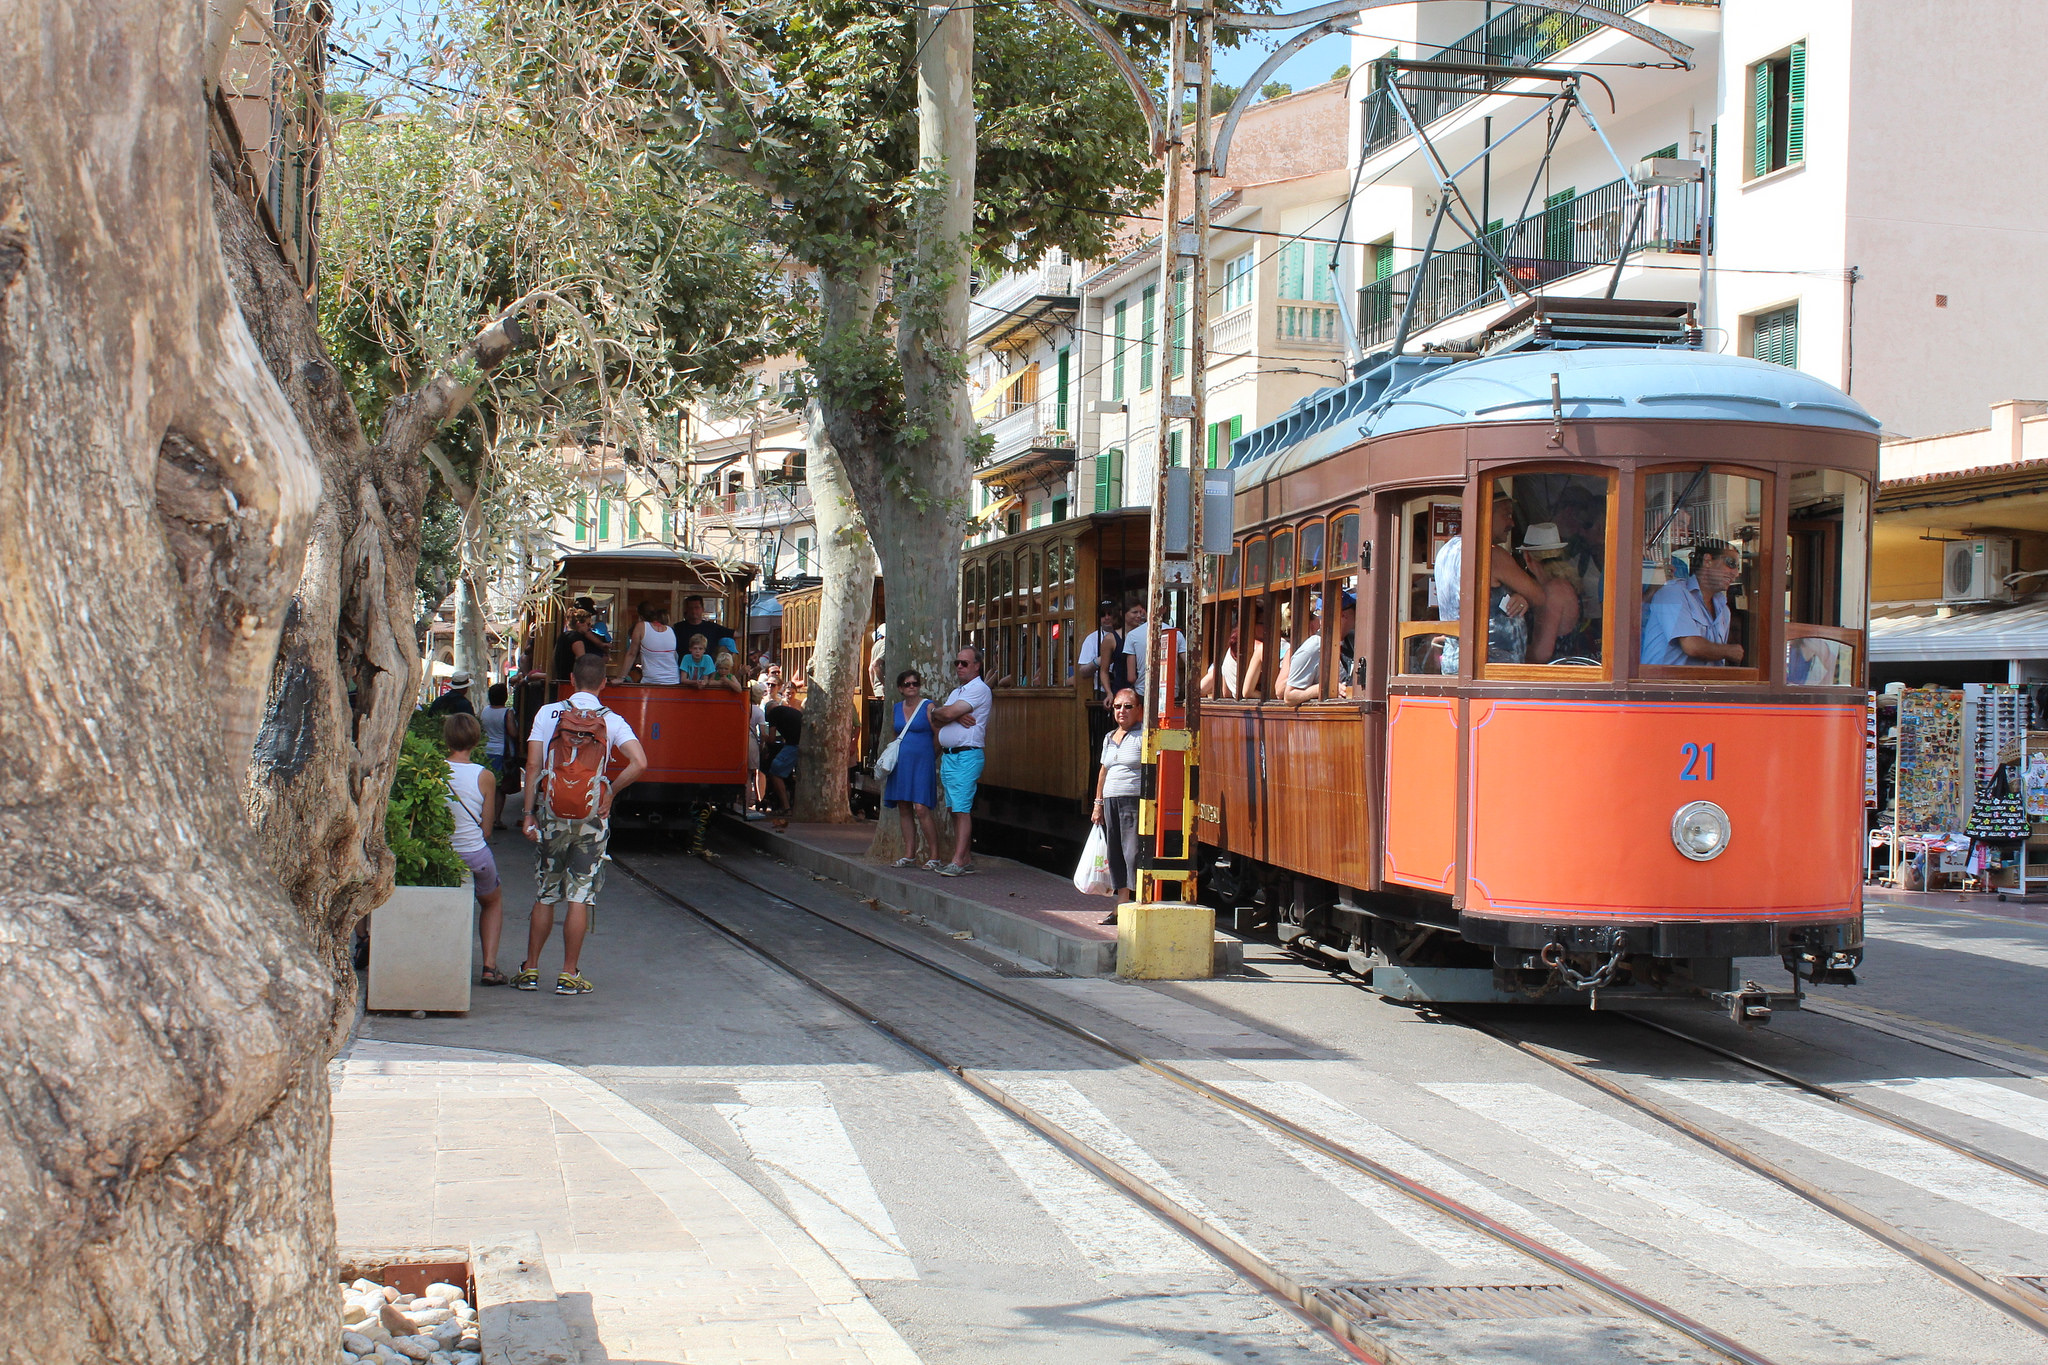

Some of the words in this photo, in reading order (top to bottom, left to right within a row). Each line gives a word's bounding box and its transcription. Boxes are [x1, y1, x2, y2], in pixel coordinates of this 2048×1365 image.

[651, 722, 661, 740] 8
[1680, 742, 1715, 781] 21
[1945, 855, 1952, 865] 2
